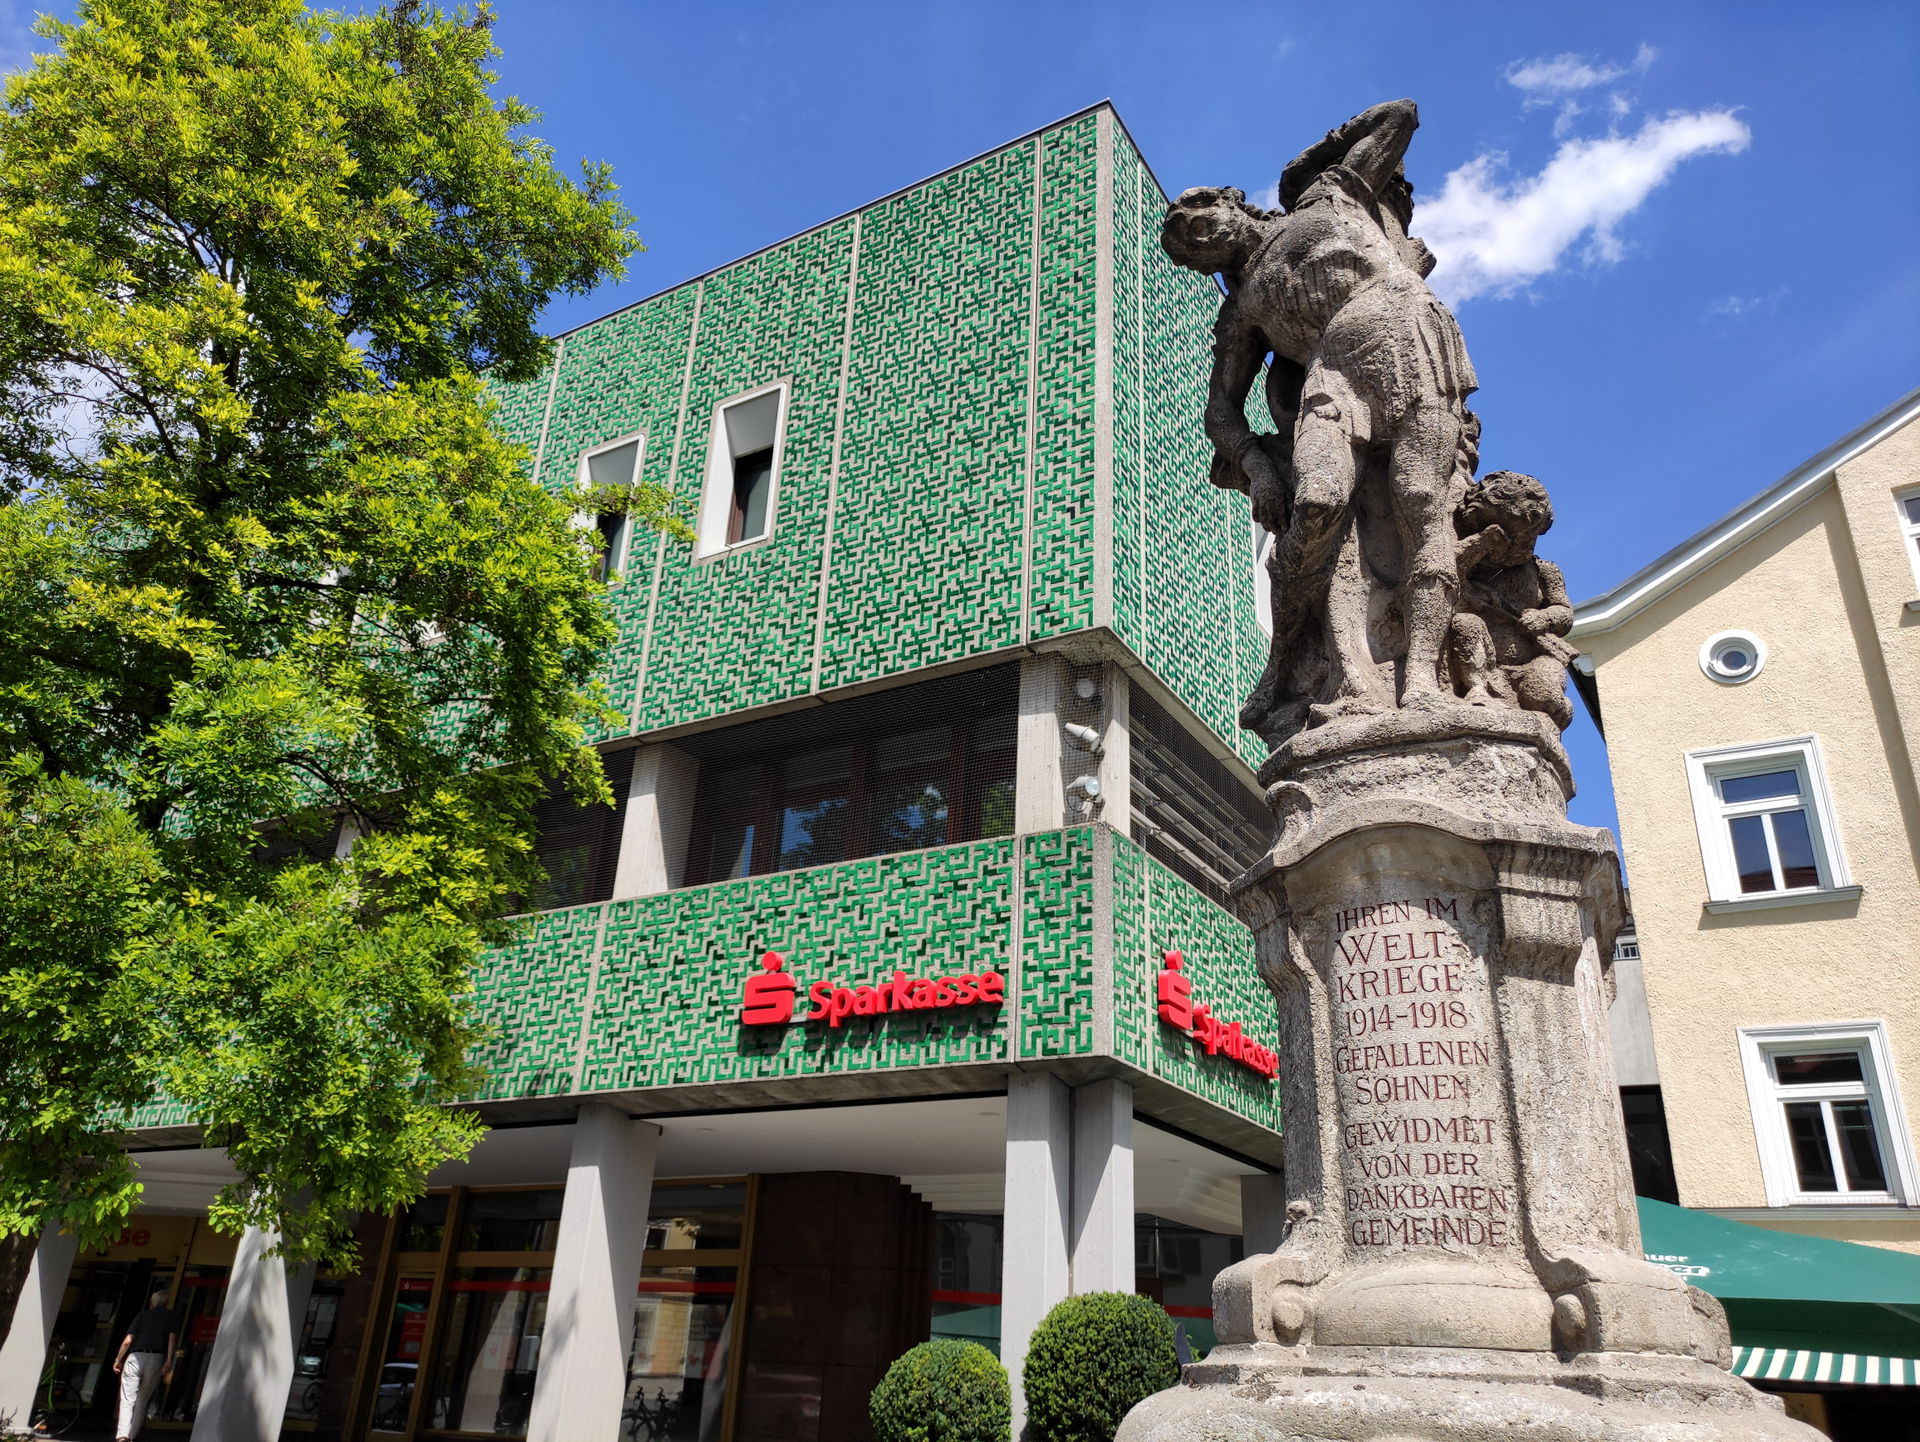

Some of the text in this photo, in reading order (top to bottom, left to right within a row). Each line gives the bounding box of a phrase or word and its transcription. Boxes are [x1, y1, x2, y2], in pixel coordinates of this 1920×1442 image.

[1335, 897, 1459, 933] IHREN IM
[1334, 931, 1463, 967] WELT-
[807, 970, 1005, 1028] Sparkasse
[1337, 964, 1463, 1004] KRIEGE
[1345, 1001, 1468, 1038] 1914-1918
[1192, 1003, 1280, 1079] Sparkasse
[1336, 1041, 1491, 1074] GEFALLENEN
[1344, 1117, 1496, 1150] GEWIDMET
[1358, 1152, 1480, 1179] VON DER
[1347, 1184, 1508, 1213] DANKBAREN
[1352, 1217, 1508, 1247] GEMEINDE
